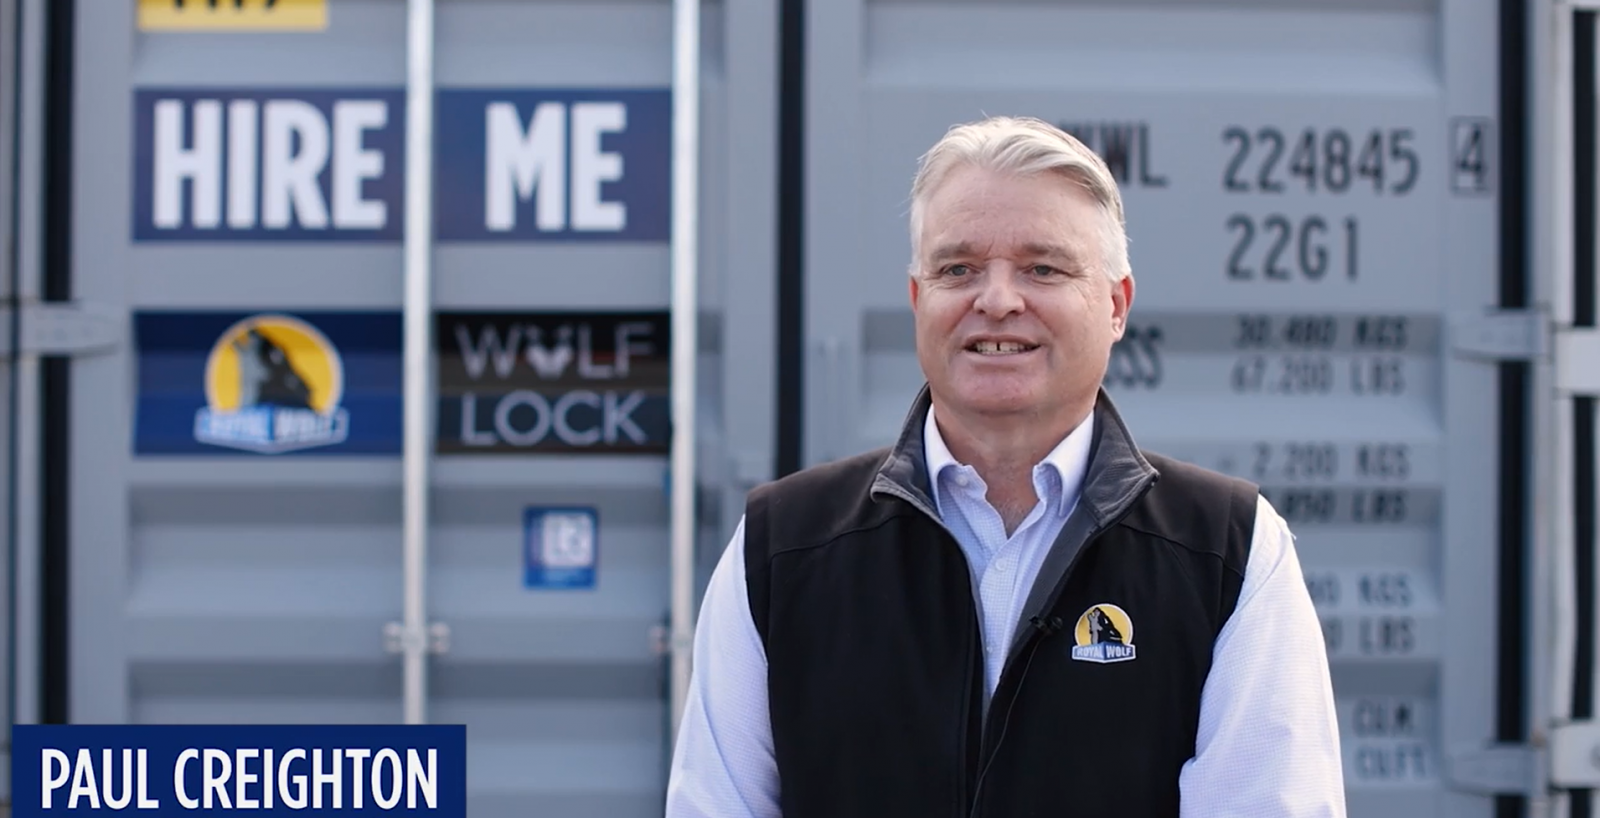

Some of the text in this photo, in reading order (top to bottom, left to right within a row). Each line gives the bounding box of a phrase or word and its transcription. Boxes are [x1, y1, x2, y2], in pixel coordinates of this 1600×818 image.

[152, 99, 627, 232] HIRE ME
[1222, 125, 1421, 196] 224845
[1454, 122, 1488, 193] 4
[1225, 211, 1359, 282] 22G1
[460, 388, 649, 447] LOCK
[1076, 644, 1132, 659] ROYAL WOLF
